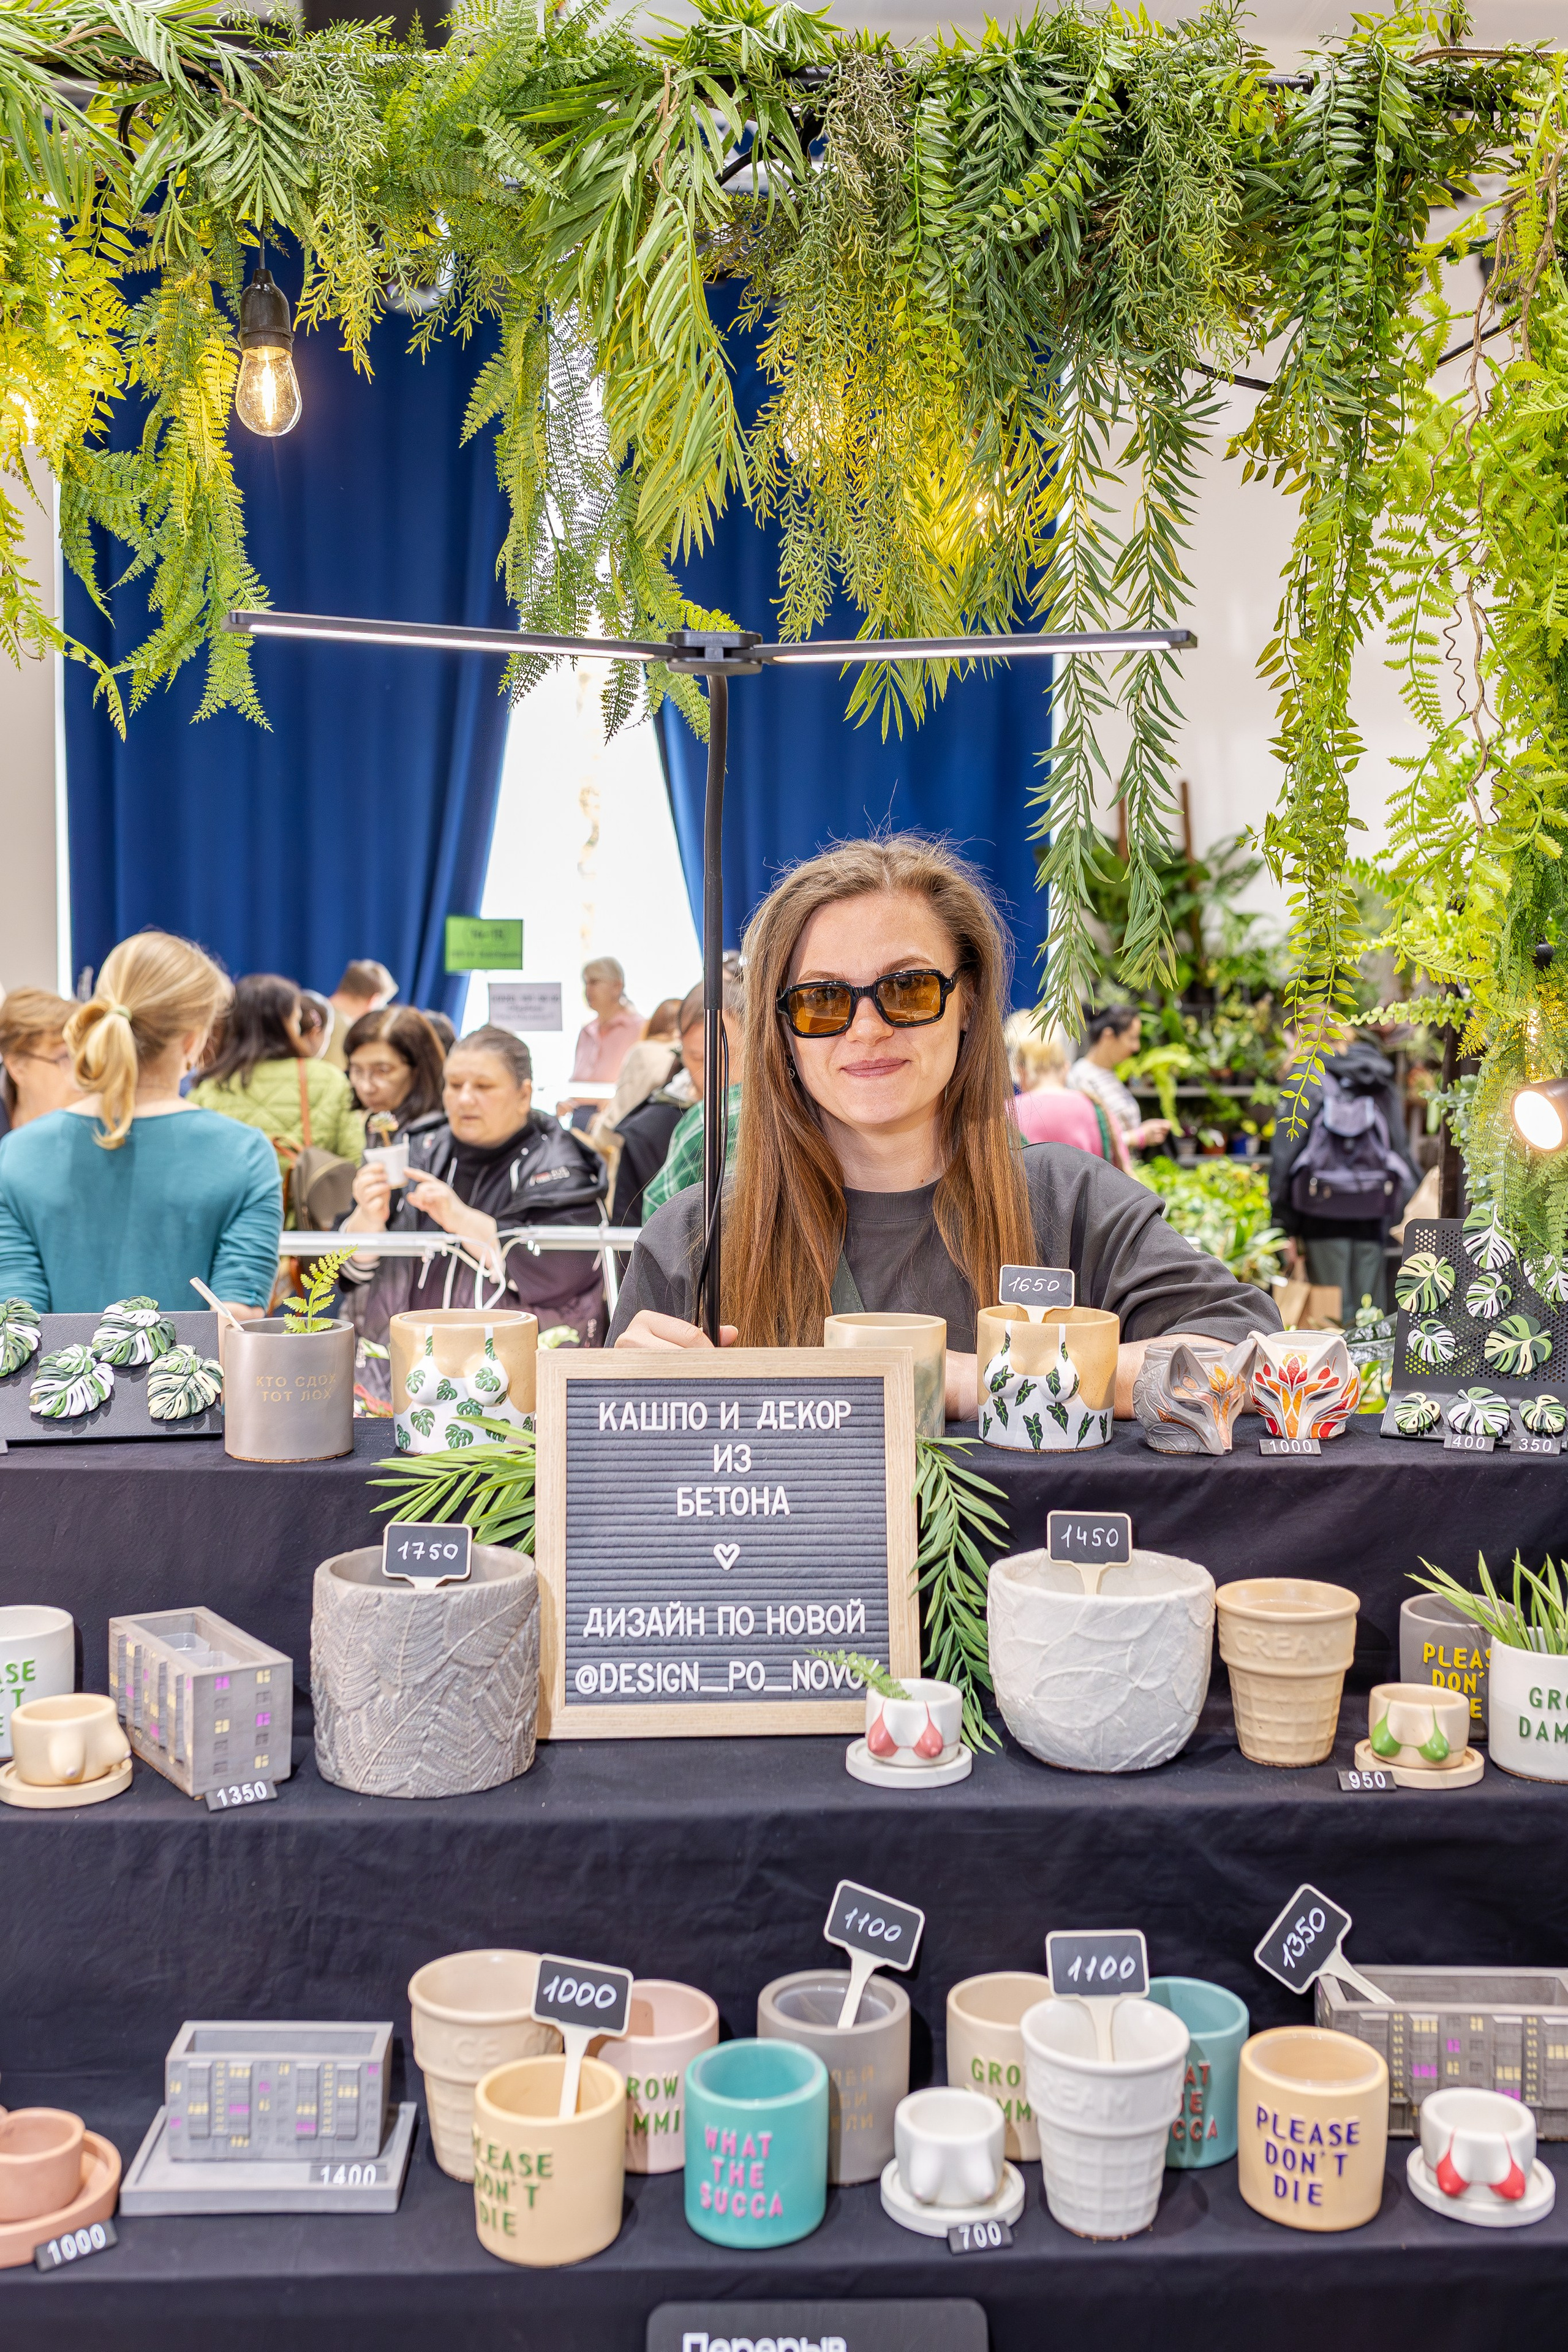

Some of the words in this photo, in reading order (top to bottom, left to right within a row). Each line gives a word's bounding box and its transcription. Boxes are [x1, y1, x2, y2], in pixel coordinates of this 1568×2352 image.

[1008, 1276, 1061, 1292] 1650
[256, 1376, 287, 1387] КТО
[262, 1390, 293, 1402] ТОТ
[300, 1387, 332, 1401] ЛОХ
[598, 1401, 708, 1431] КАШПО
[720, 1401, 739, 1431] И
[756, 1400, 852, 1430] ДЕКОР
[1269, 1439, 1312, 1453] 1000
[1452, 1435, 1485, 1450] 400
[1518, 1438, 1553, 1452] 350
[713, 1443, 752, 1473] ИЗ
[676, 1485, 791, 1517] БЕТОНА
[397, 1540, 459, 1561] 1750
[1060, 1524, 1119, 1548] 1450
[582, 1600, 705, 1638] ДИЗАЙН
[717, 1605, 755, 1637] ПО
[766, 1598, 866, 1635] НОВОЙ
[1529, 1687, 1568, 1710] GR
[216, 1781, 268, 1807] 1350
[1349, 1771, 1386, 1789] 950
[845, 1907, 902, 1942] 1100
[1282, 1907, 1326, 1969] 1350
[1068, 1955, 1136, 1982] 1100
[543, 1975, 617, 2009] 1000
[1257, 2105, 1360, 2146] PLEASE
[705, 2124, 773, 2158] WHAT
[712, 2155, 765, 2190] THE
[1265, 2140, 1349, 2177] DON'T
[320, 2163, 377, 2186] 1400
[700, 2180, 784, 2219] SUCCA
[1275, 2174, 1323, 2207] DIE
[480, 2198, 518, 2237] DIE
[47, 2223, 107, 2265] 1000
[958, 2220, 1003, 2250] 700
